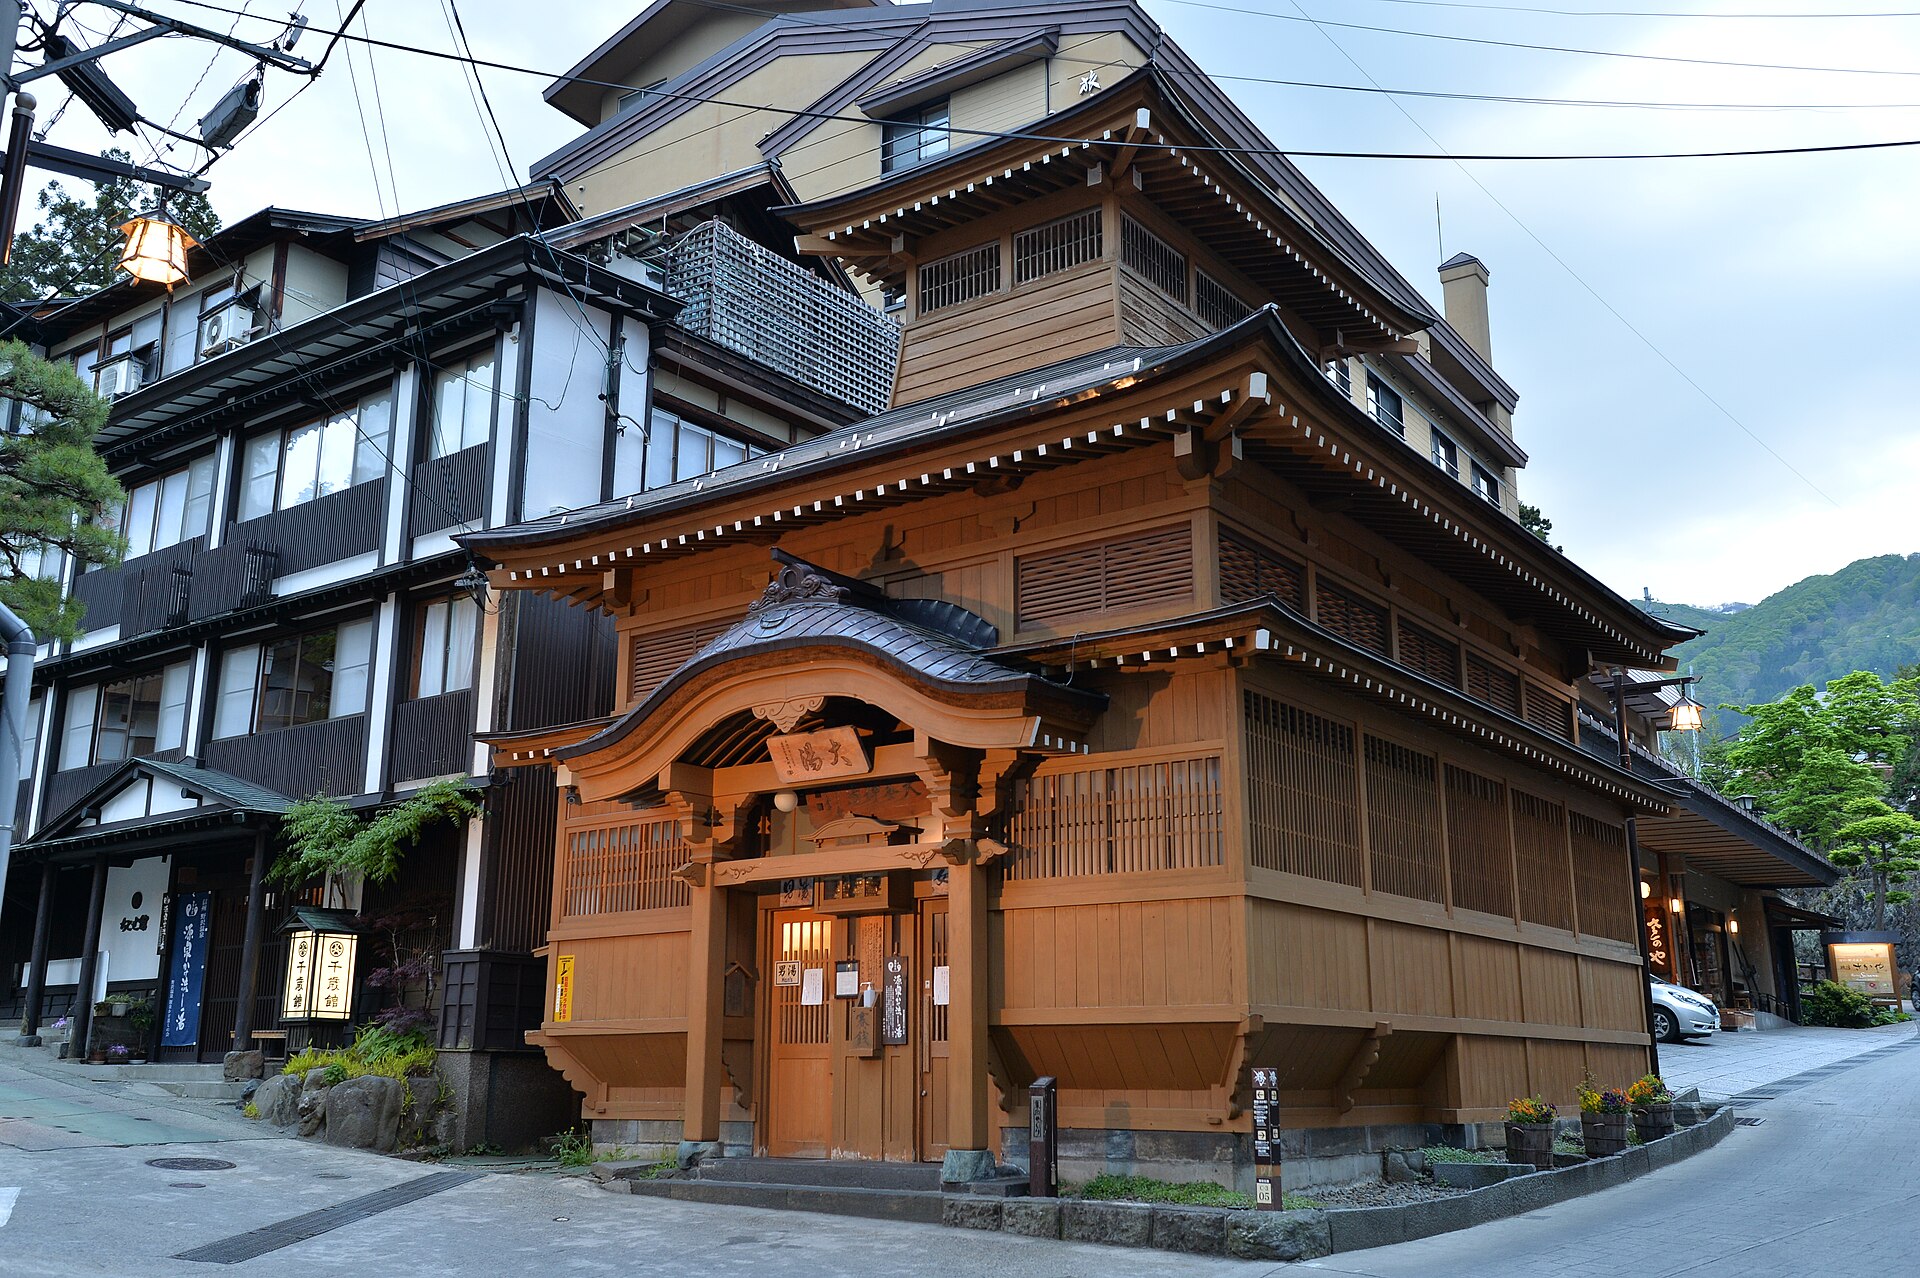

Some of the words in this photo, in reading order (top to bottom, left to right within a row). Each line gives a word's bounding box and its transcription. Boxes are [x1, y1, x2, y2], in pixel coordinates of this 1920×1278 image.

[293, 961, 306, 1008] 千歳館
[324, 961, 342, 1008] 千歳館
[778, 964, 797, 977] 男湯
[1258, 1191, 1270, 1201] 05
